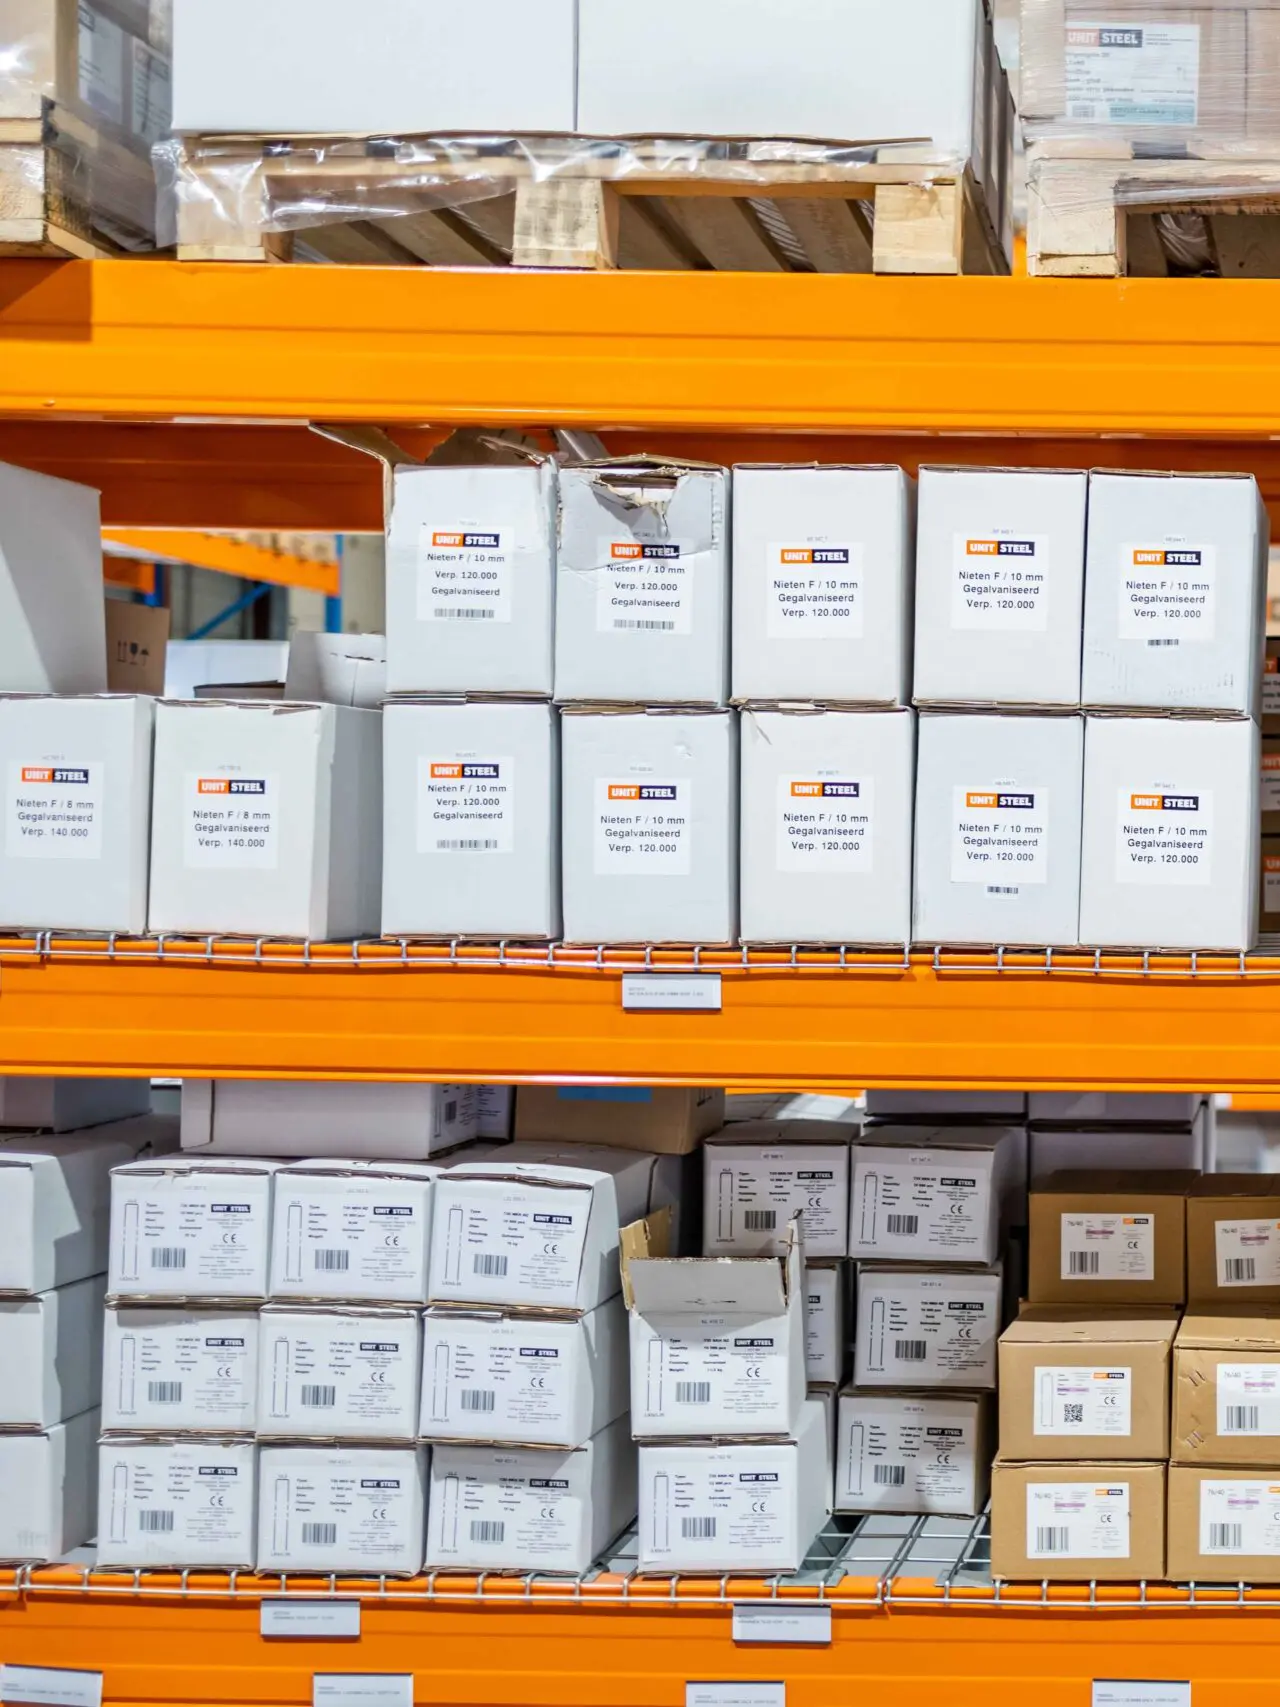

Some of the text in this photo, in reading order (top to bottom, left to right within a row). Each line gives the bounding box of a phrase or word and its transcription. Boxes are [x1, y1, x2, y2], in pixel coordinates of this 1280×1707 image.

[1067, 32, 1098, 43] UNIT
[1102, 32, 1138, 44] STEEL
[436, 535, 497, 545] UNIT STEEL
[615, 547, 676, 557] UNIT STEEL
[970, 543, 1032, 553] UNIT STEEL
[784, 551, 847, 561] UNIT STEEL
[1137, 553, 1199, 563] UNIT STEEL
[435, 571, 497, 579] Verp. 120.000
[774, 580, 805, 589] Nieten
[809, 580, 815, 588] F
[826, 580, 836, 589] 10
[963, 584, 1039, 595] Gegalvaniseerd
[431, 587, 500, 596] Gegalvaniseerd
[611, 597, 680, 607] Gegalvaniseerd
[778, 593, 854, 604] Gegalvaniseerd
[1130, 594, 1205, 605] Gegalvaniseerd
[966, 599, 1035, 610] Verp. 120.000
[782, 608, 850, 618] Verp. 120.000
[25, 770, 86, 781] UNIT STEEL
[434, 766, 497, 776] UNIT STEEL
[201, 781, 263, 792] UNIT STEEL
[794, 785, 857, 795] UNIT STEEL
[612, 788, 674, 798] UNIT STEEL
[436, 799, 460, 807] Verp.
[970, 796, 1032, 806] UNIT STEEL
[1134, 798, 1196, 808] UNIT STEEL
[18, 812, 92, 822] Gegalvaniseerd
[433, 812, 503, 821] Gegalvaniseerd
[783, 813, 815, 822] Nieten
[819, 813, 825, 821] F
[836, 814, 847, 823] 10
[194, 823, 269, 834] Gegalvaniseerd
[605, 828, 680, 839] Gegalvaniseerd
[788, 826, 864, 837] Gegalvaniseerd
[198, 838, 265, 847] Verp. 140.000
[791, 841, 860, 851] Verp. 120.000
[963, 836, 1038, 847] Gegalvaniseerd
[1127, 838, 1203, 850] Gegalvaniseerd
[1131, 853, 1199, 864] Verp. 120.000
